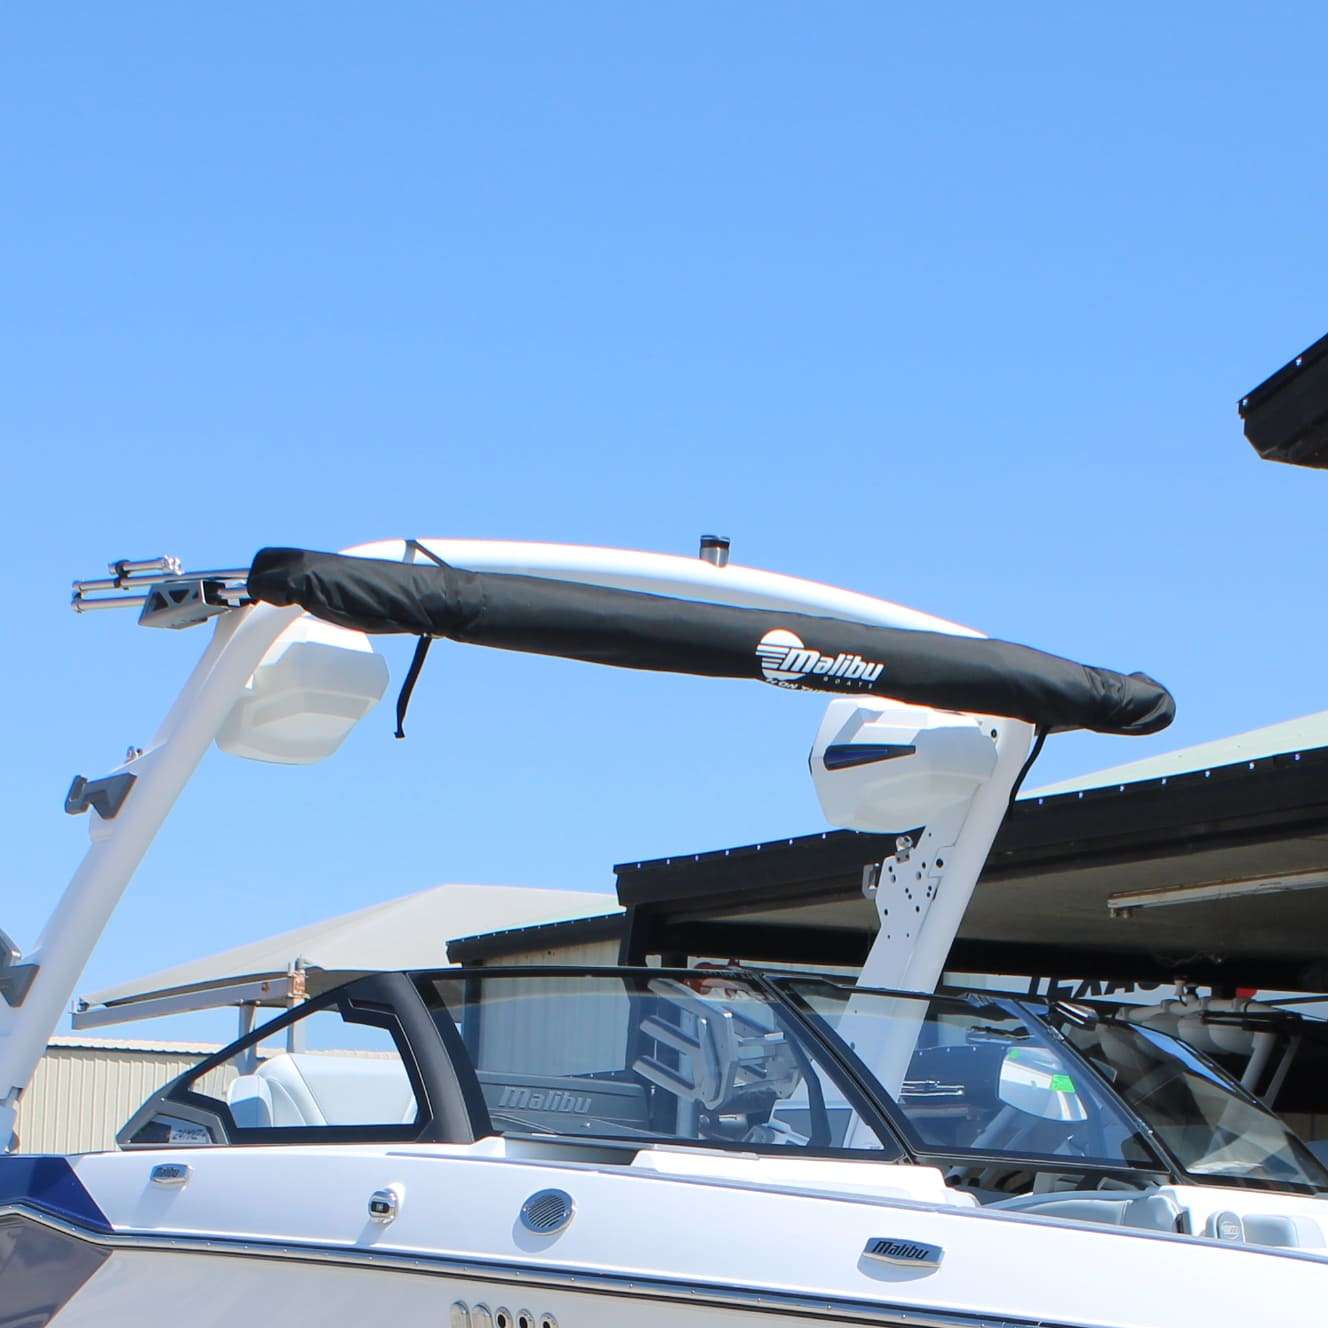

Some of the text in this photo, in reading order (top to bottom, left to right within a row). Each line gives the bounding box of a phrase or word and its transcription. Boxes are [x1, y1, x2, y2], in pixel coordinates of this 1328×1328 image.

[779, 647, 885, 682] Malibu
[498, 1085, 592, 1114] Malibu
[872, 1241, 929, 1260] Malibu
